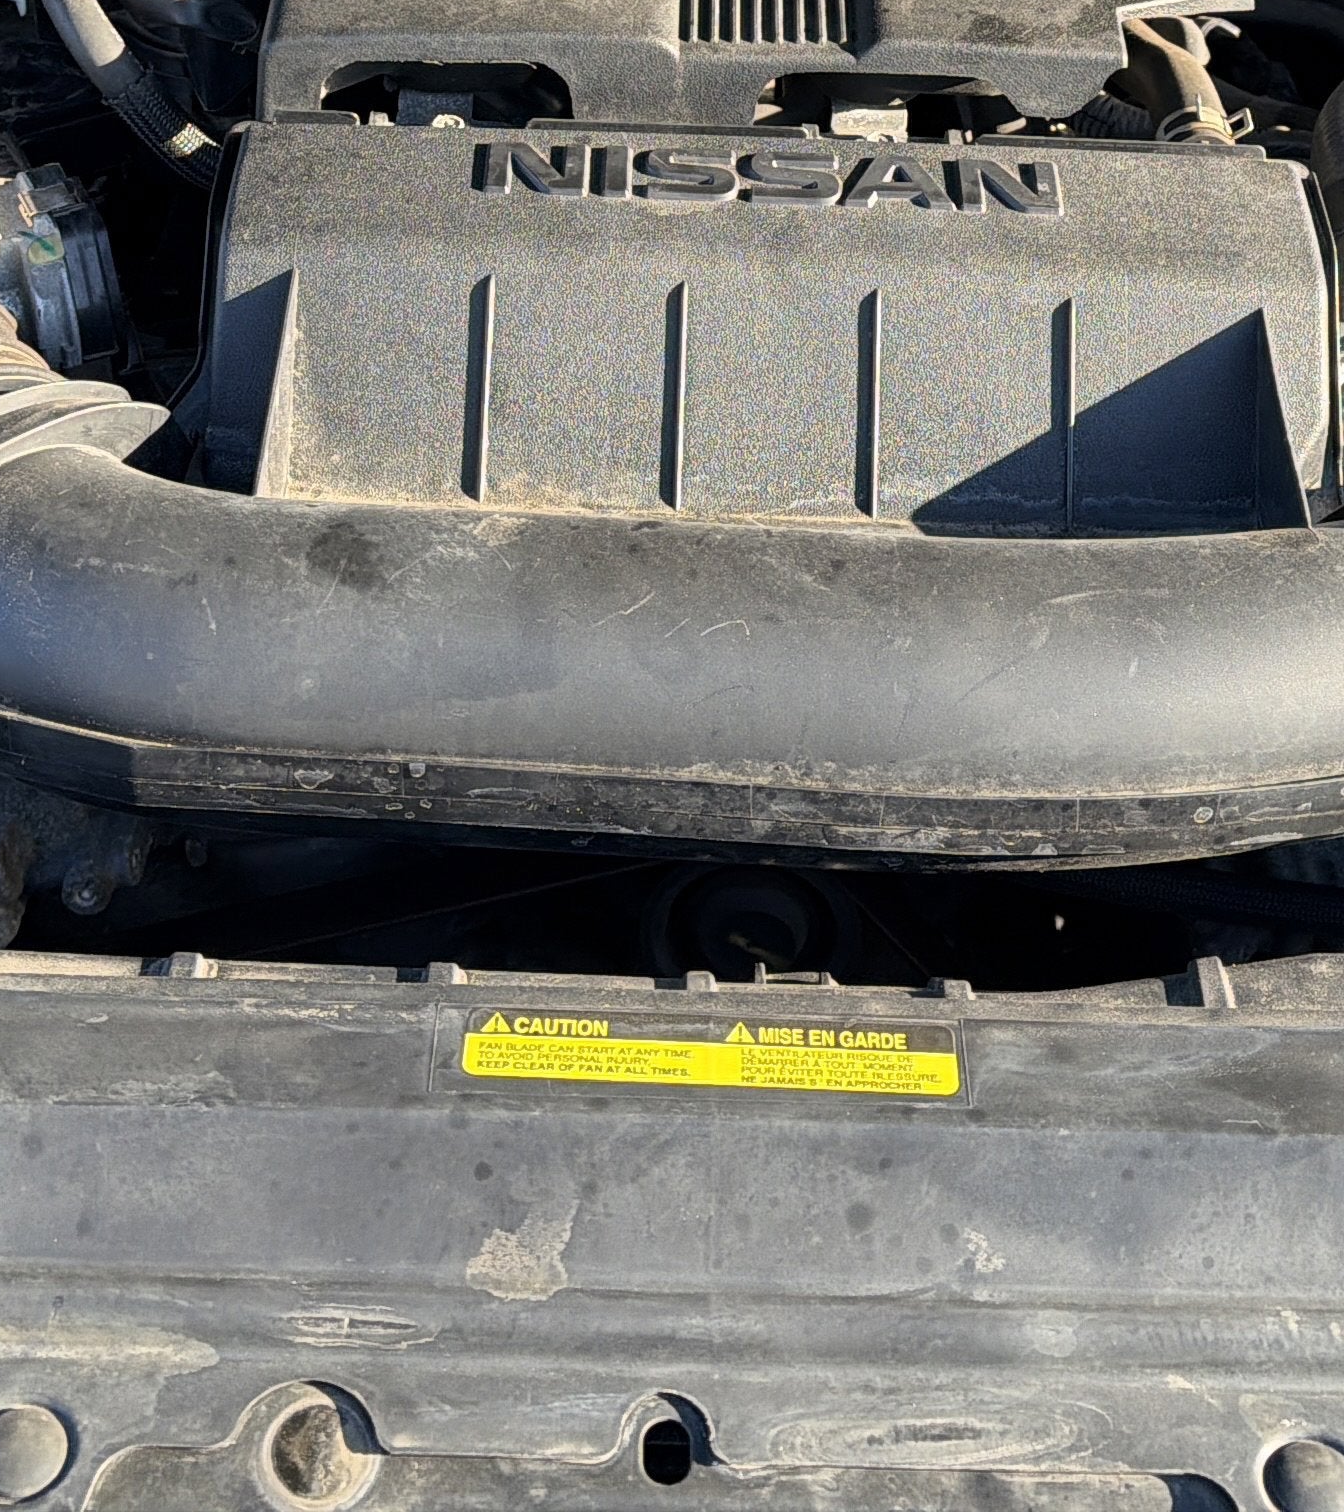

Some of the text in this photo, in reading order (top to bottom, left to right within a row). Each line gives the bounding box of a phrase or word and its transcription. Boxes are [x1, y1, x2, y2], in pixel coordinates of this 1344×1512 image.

[478, 139, 1066, 215] NISSAN
[513, 1017, 608, 1037] CAUTION
[758, 1027, 908, 1050] MISE EN GARDE
[479, 1041, 502, 1050] FAN
[505, 1042, 545, 1052] BLADE
[549, 1043, 575, 1053] CAN
[578, 1045, 615, 1054] START
[619, 1047, 633, 1055] AT
[636, 1047, 662, 1057] ANY
[741, 1049, 913, 1063] LE VENTILATEUR RISQUE DE
[479, 1050, 494, 1059] TO
[497, 1051, 534, 1061] AVOID
[537, 1053, 602, 1064] PERSONAL
[477, 1061, 510, 1069] KEEP
[513, 1062, 554, 1071] CLEAR
[559, 1063, 574, 1072] OF
[578, 1064, 603, 1073] FAN
[606, 1065, 620, 1074] AT
[624, 1065, 648, 1075] ALL
[741, 1066, 775, 1075] POUR
[827, 1069, 868, 1079] TOUTE
[824, 1061, 855, 1070] TOUT
[863, 1062, 914, 1072] MOMENT
[741, 1076, 758, 1084] NE
[762, 1076, 806, 1086] JAMAIS
